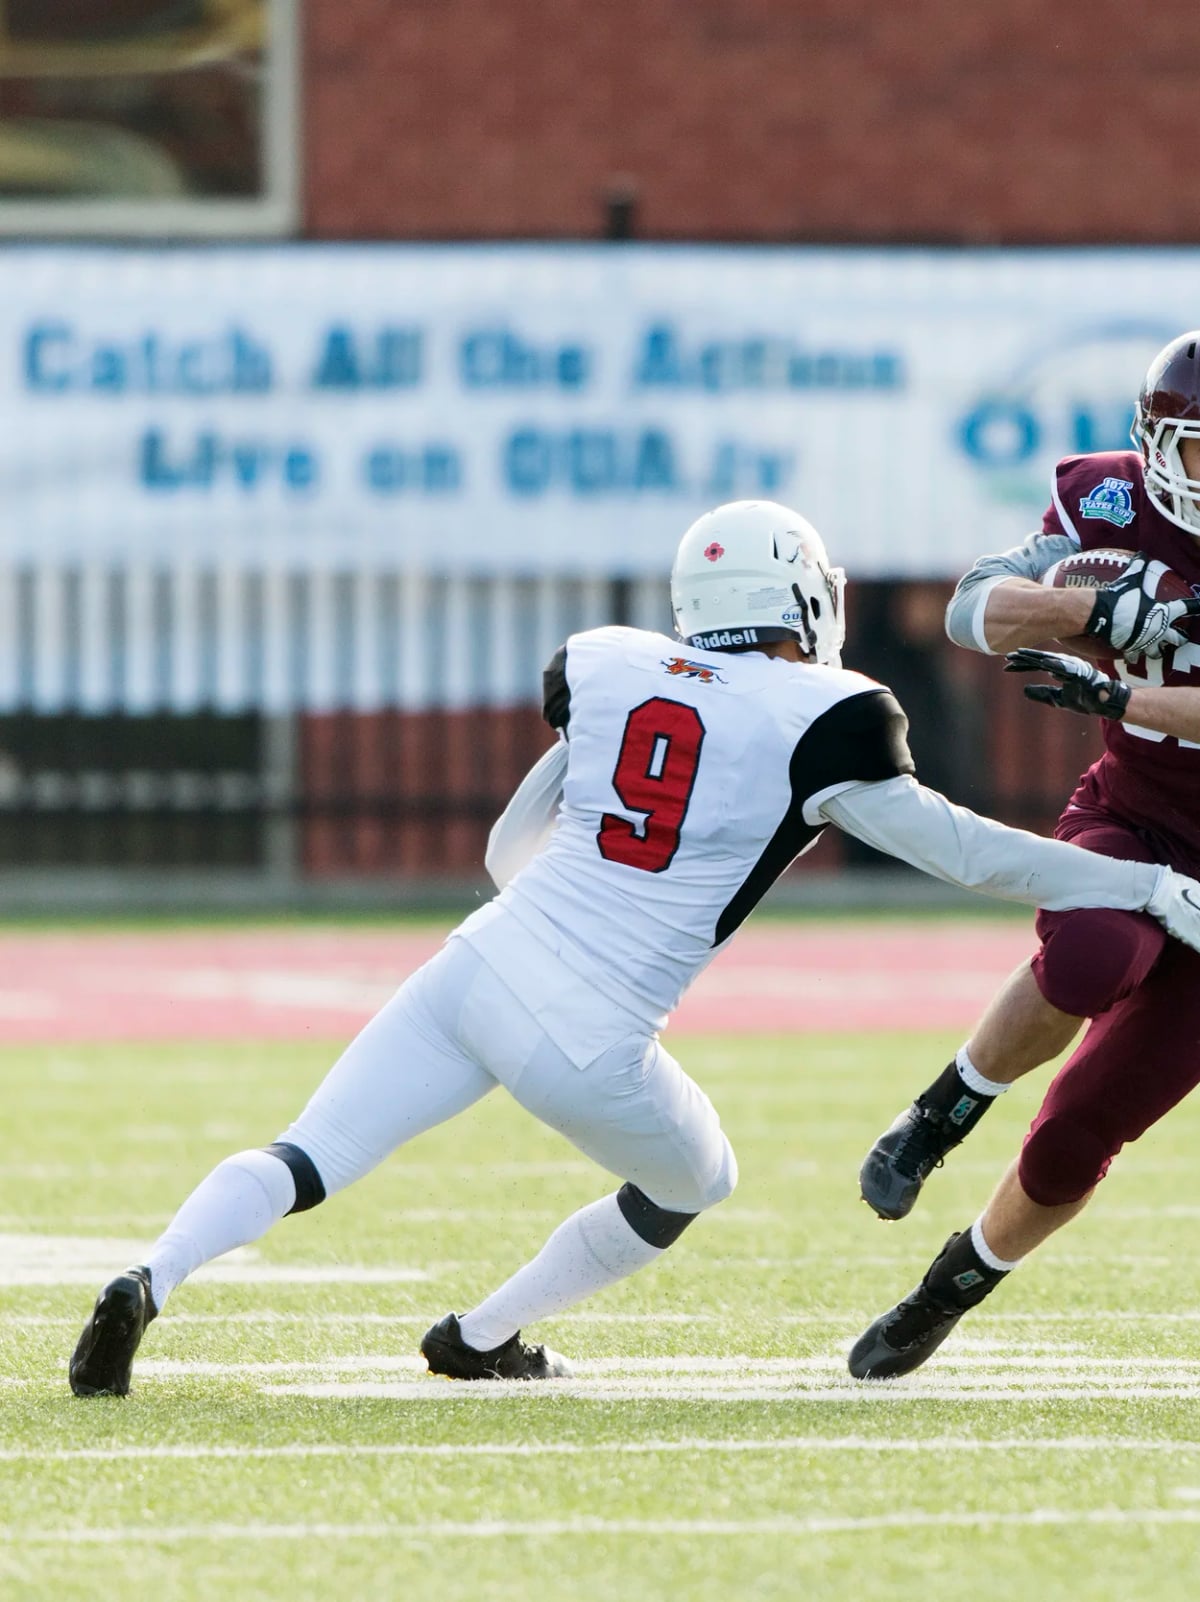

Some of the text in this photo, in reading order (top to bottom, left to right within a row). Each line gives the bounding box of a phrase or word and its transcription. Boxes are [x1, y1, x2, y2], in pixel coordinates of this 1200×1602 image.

[24, 323, 904, 392] Catch All the Action
[138, 426, 318, 494] Live
[364, 438, 462, 494] on
[1065, 574, 1110, 589] Wilso
[691, 629, 758, 649] Riddell
[597, 696, 706, 873] 9
